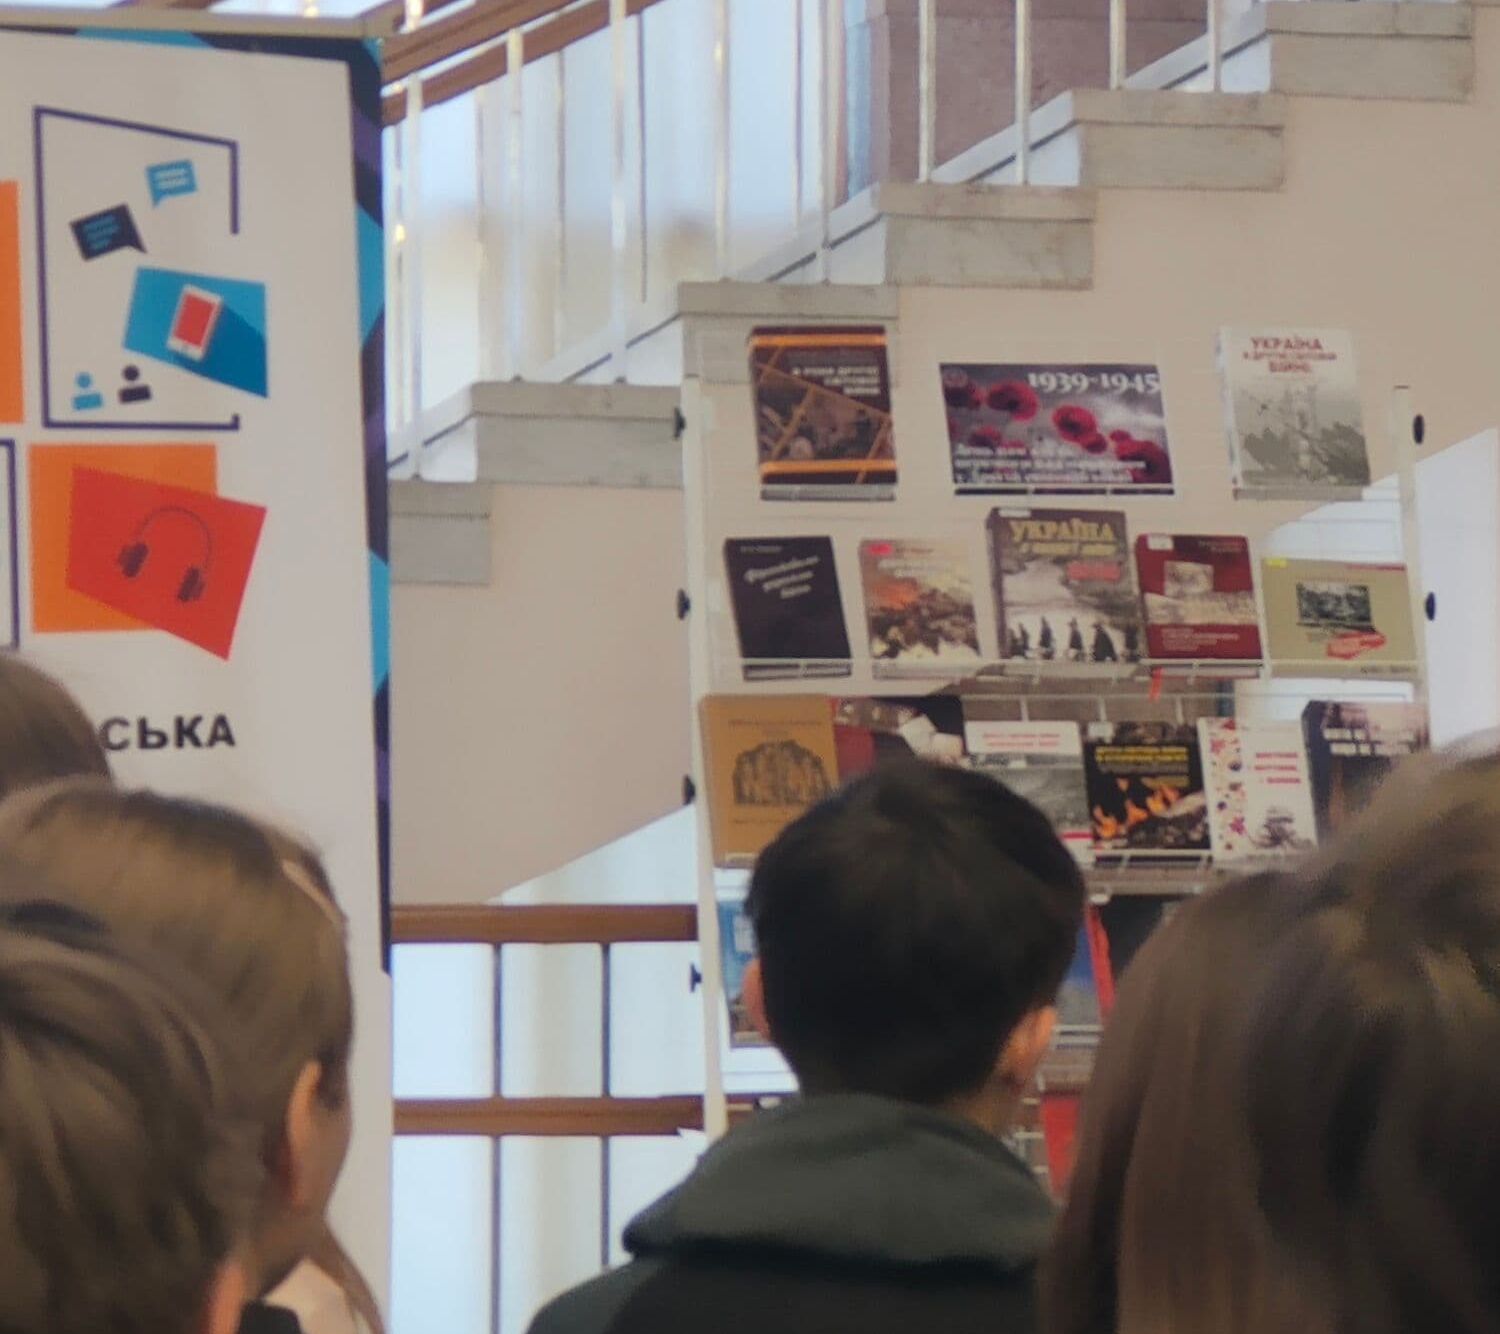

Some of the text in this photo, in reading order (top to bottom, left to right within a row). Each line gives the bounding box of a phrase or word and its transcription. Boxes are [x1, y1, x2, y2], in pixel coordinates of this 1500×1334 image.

[1250, 334, 1323, 349] УКРАЇНА
[1027, 371, 1160, 393] 1939-1945
[1009, 517, 1115, 543] УКРАЇНА
[99, 713, 235, 751] СЬКА
